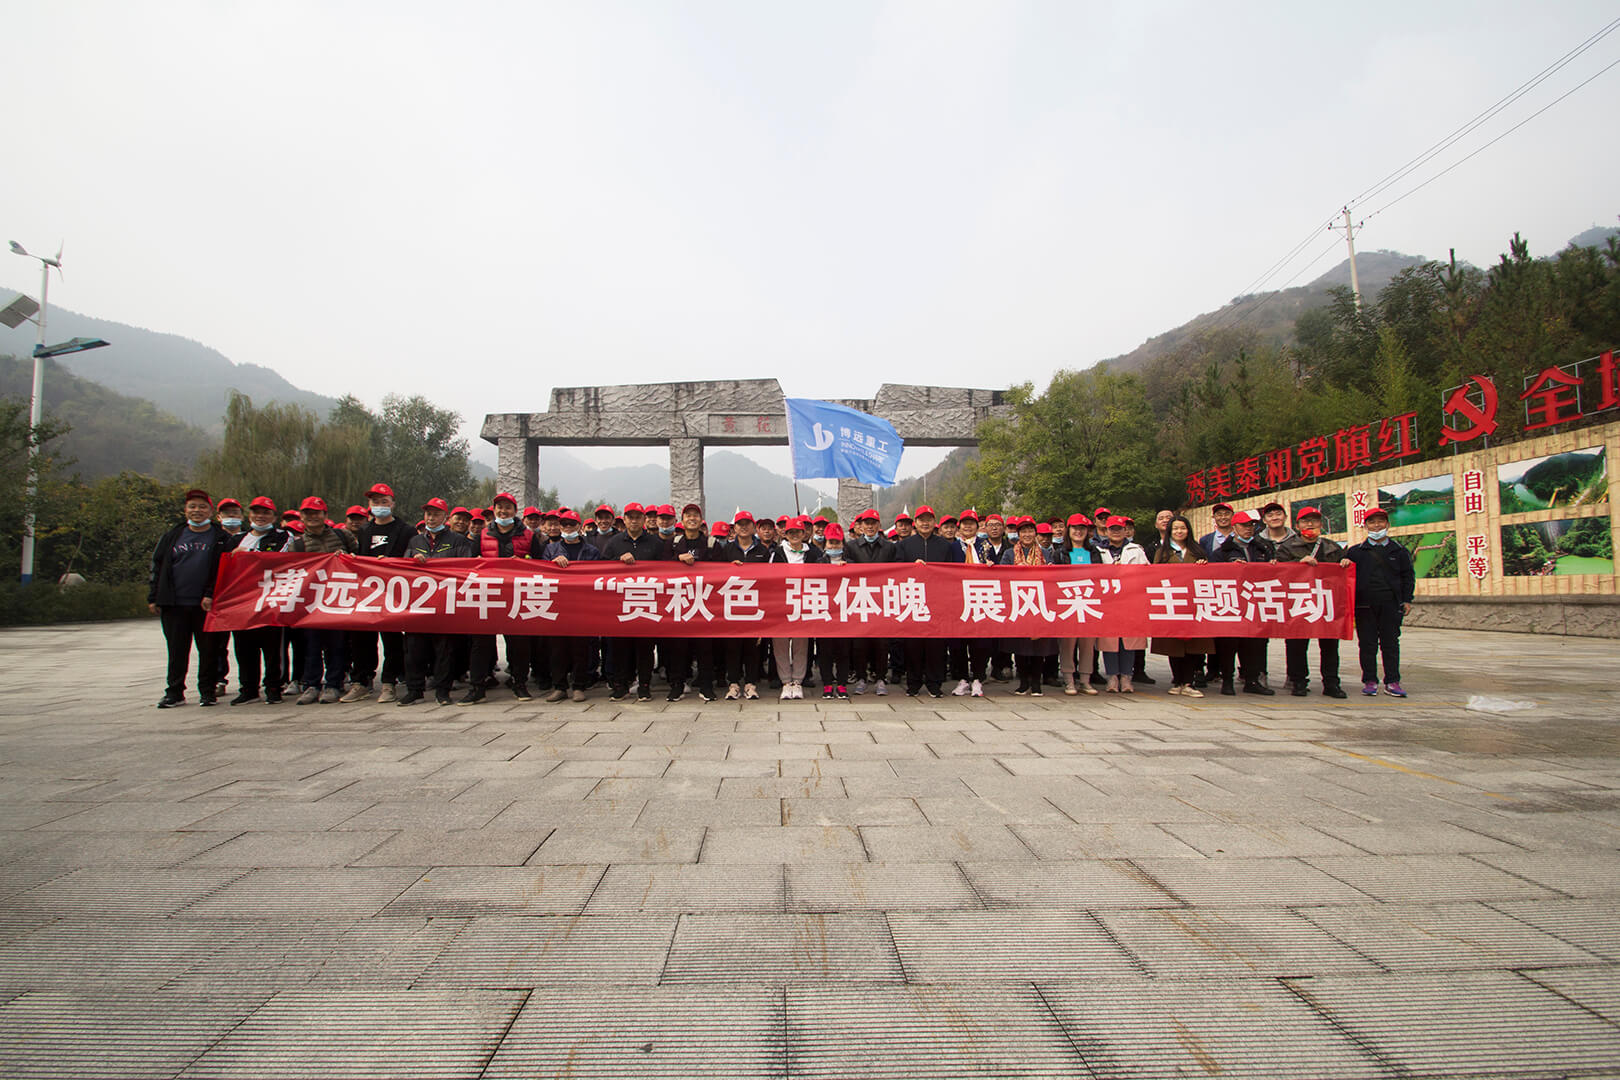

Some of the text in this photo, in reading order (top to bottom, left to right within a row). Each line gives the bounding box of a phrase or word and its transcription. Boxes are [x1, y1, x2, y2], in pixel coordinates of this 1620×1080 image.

[840, 427, 888, 453] 博远重工
[1185, 411, 1420, 506] 秀美泰和党旗红
[1353, 491, 1366, 526] 文明
[1464, 471, 1487, 577] 自由 平等
[254, 568, 1334, 623] 博远2021年度 “赏秋色 强体魄 展风采” 主题活动
